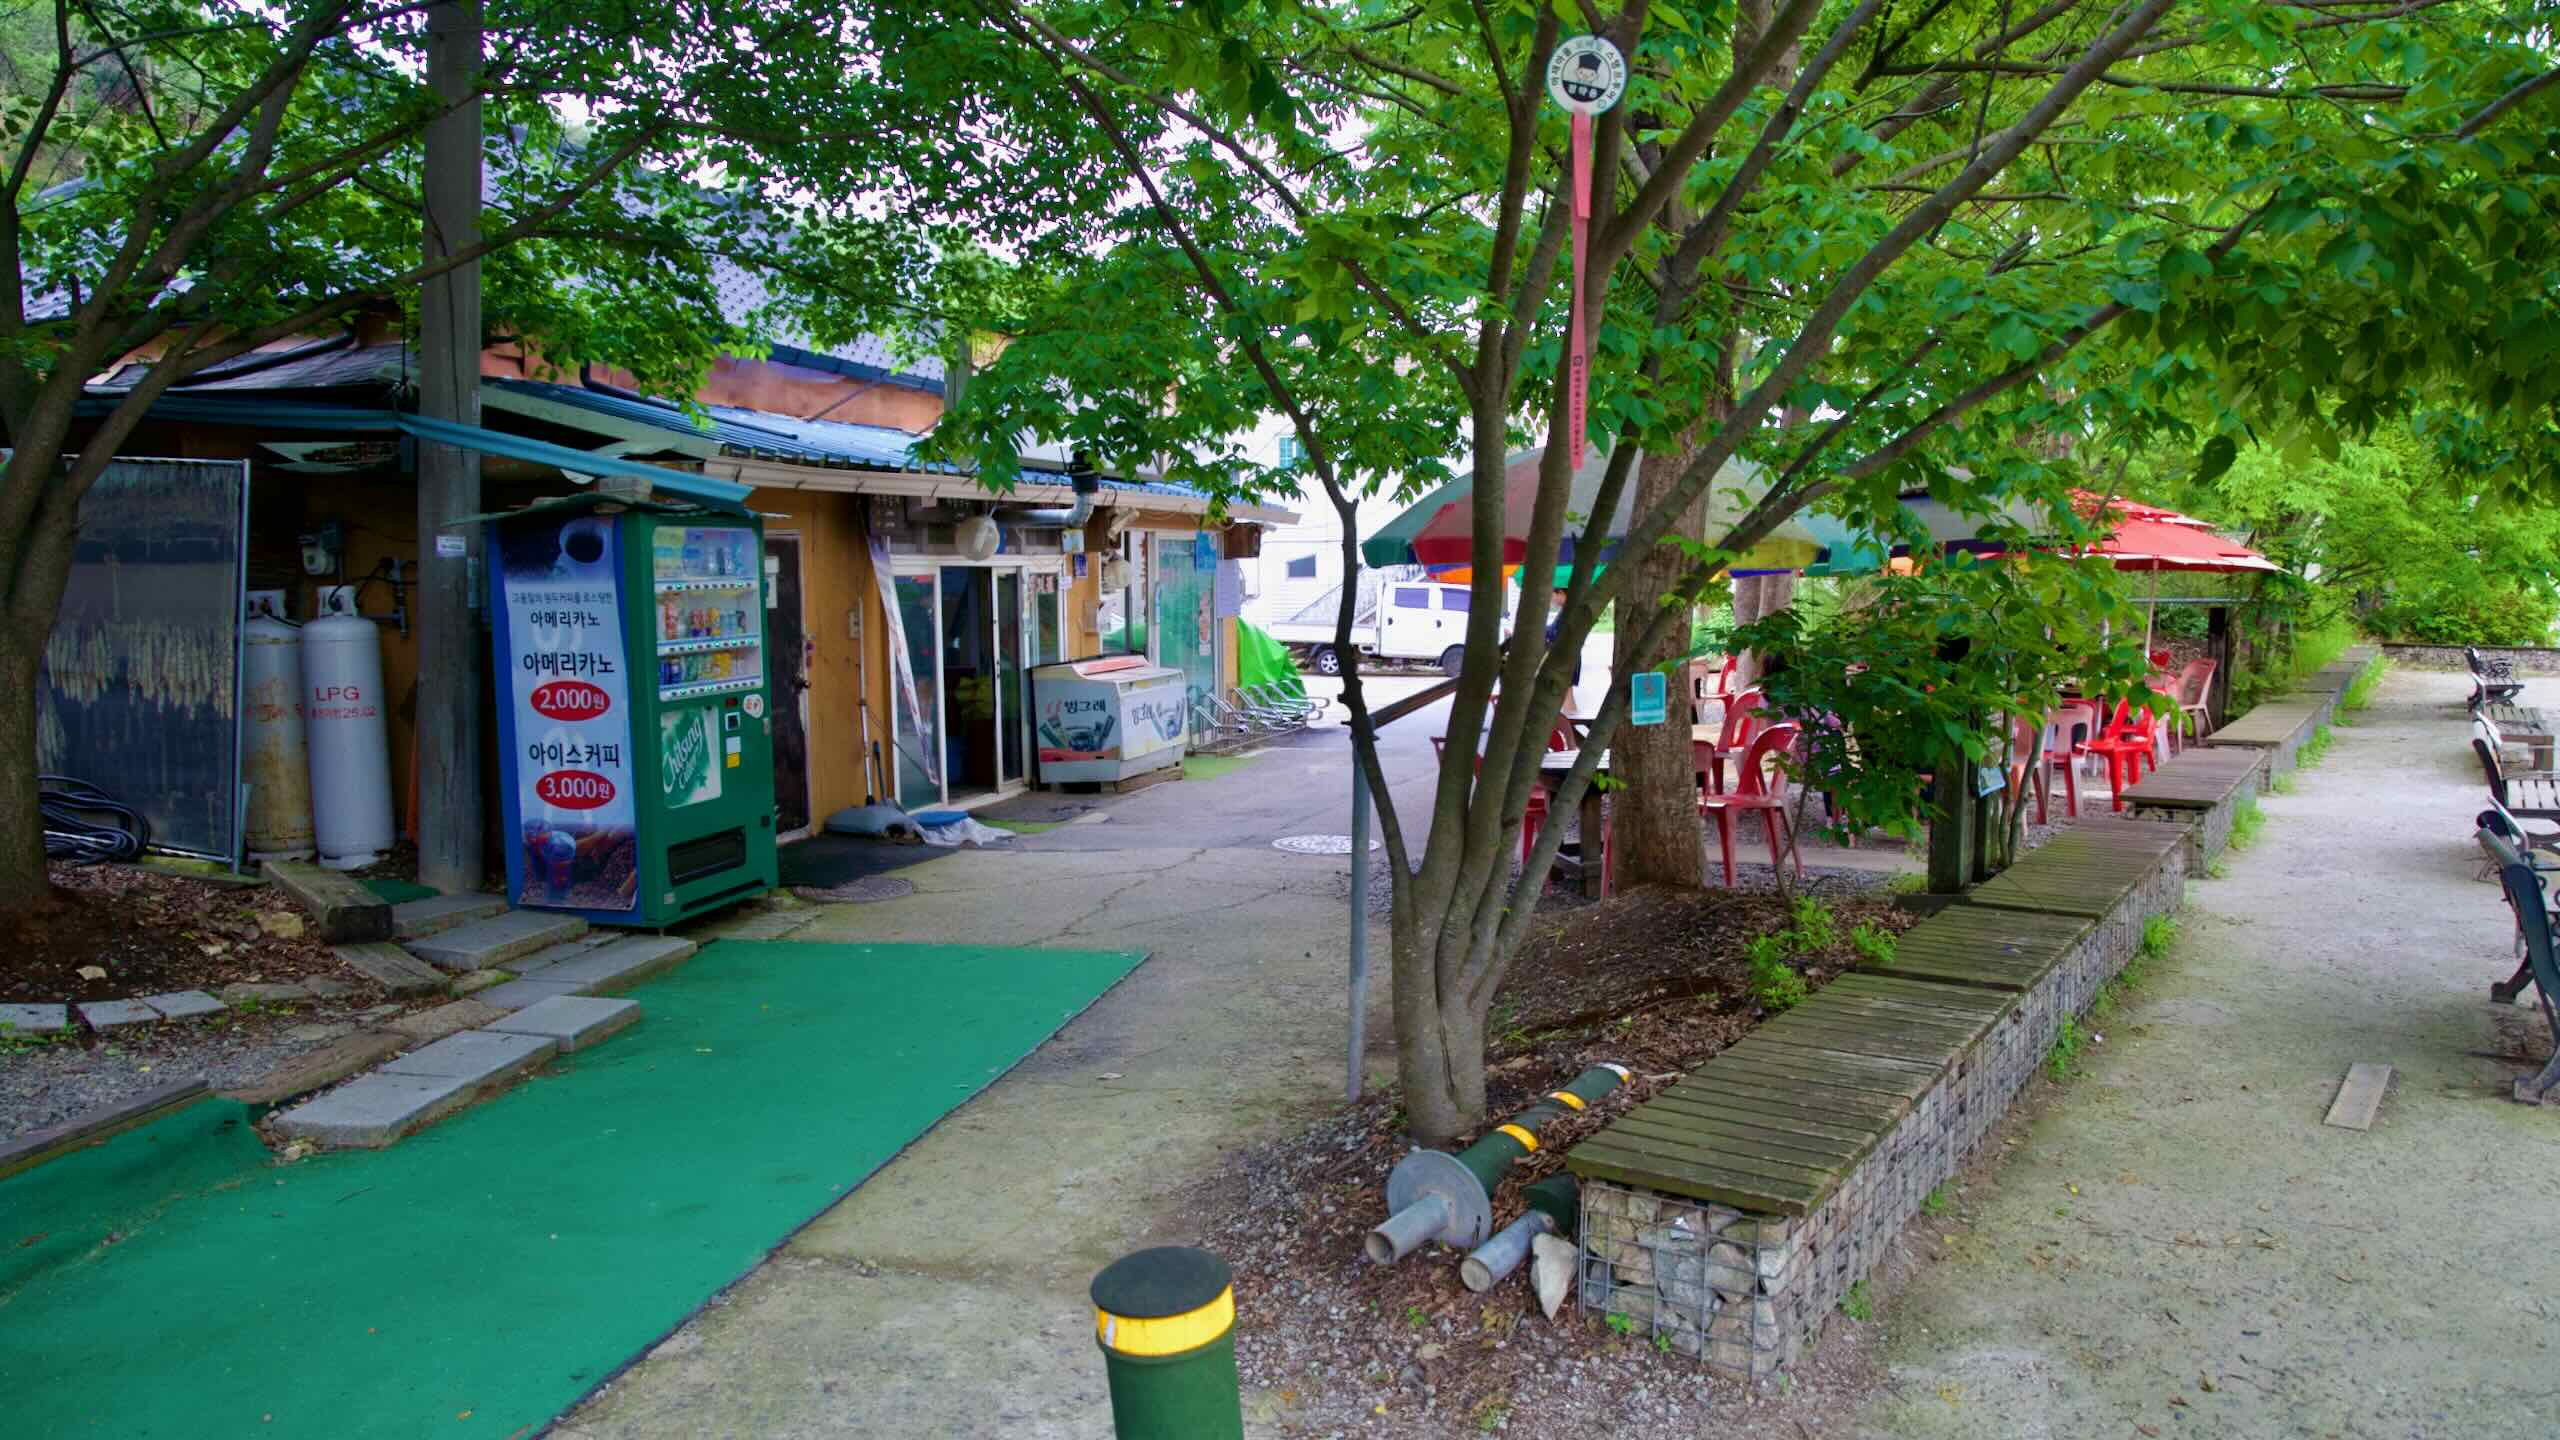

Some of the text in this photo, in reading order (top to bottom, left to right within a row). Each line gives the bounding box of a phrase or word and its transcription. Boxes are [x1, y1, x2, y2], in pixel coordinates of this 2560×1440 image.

[530, 609, 601, 628] 아메리카노
[523, 651, 616, 677] 아메리카노
[315, 686, 360, 702] LPG
[1064, 699, 1106, 714] 빙그레
[529, 743, 620, 768] 아이스커피
